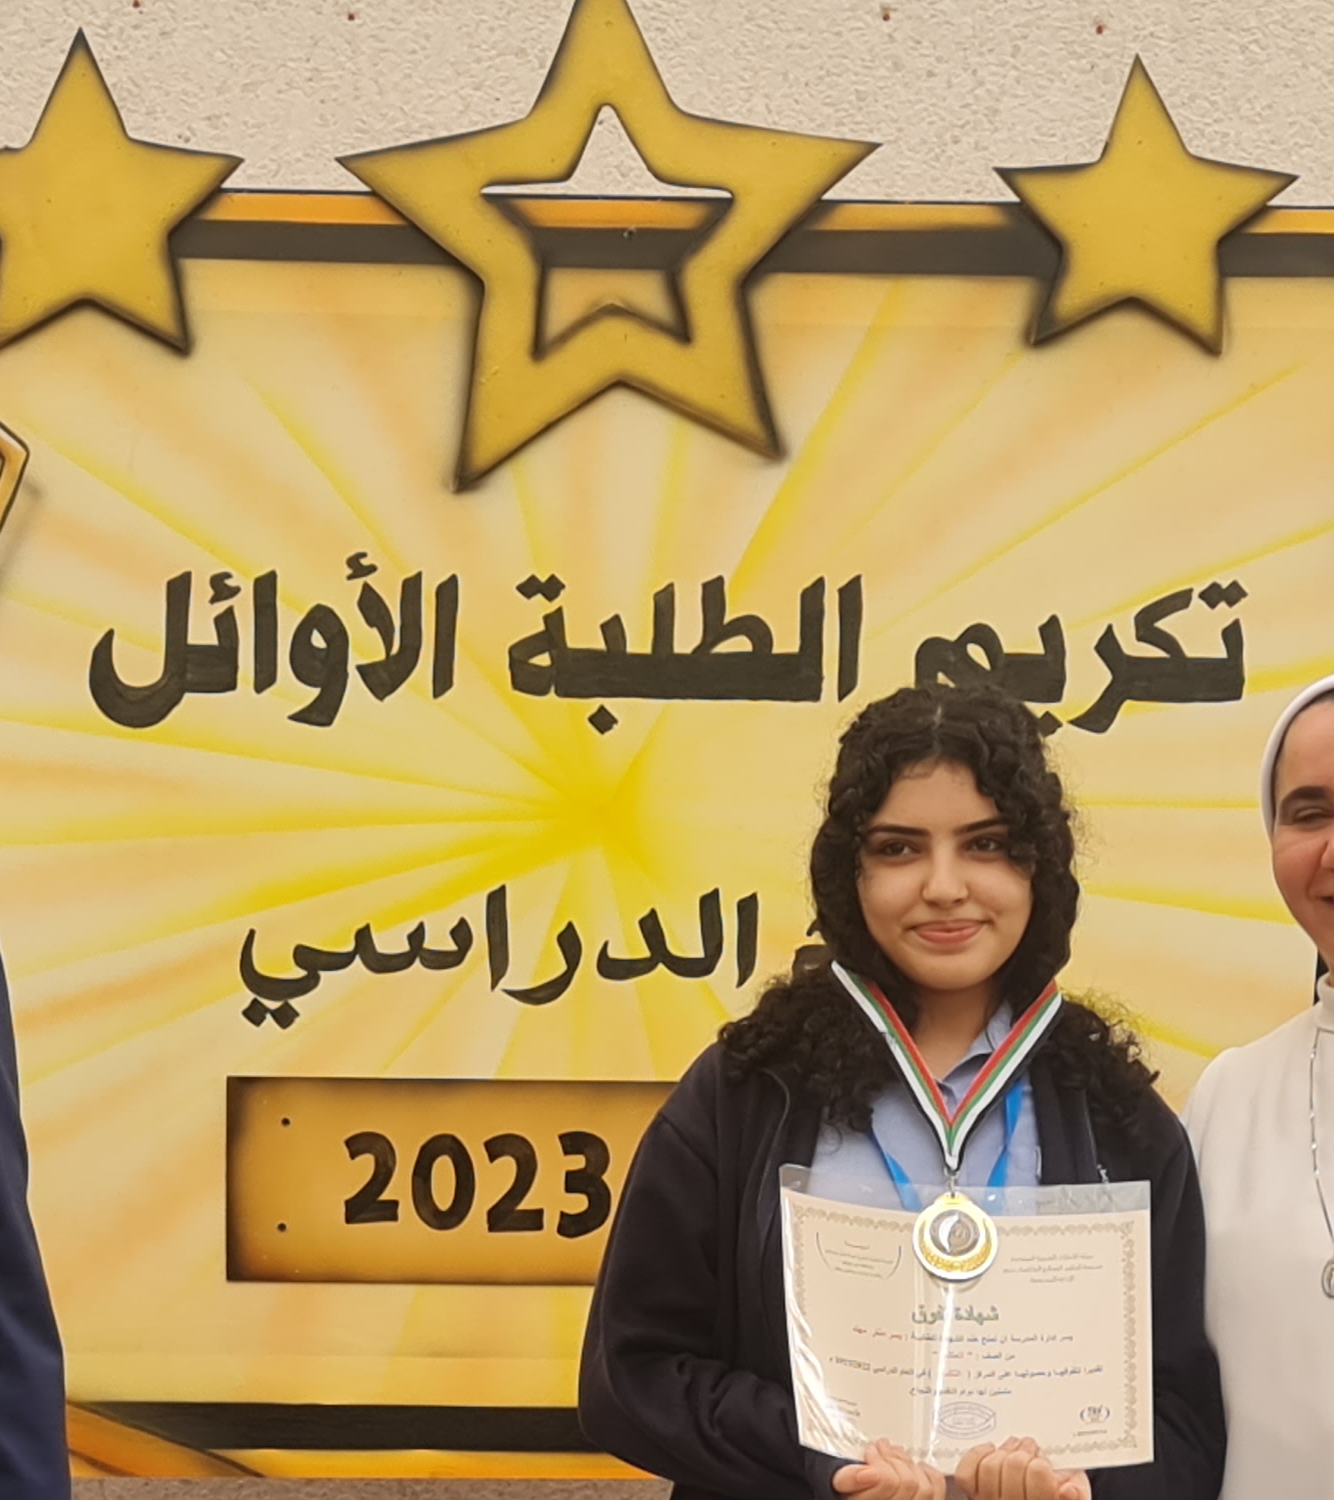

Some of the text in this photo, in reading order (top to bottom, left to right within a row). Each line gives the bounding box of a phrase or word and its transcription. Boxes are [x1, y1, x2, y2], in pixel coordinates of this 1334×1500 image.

[88, 551, 1249, 737] تكريم الطلبة الأوائل
[239, 883, 759, 1031] الدراسي
[344, 1131, 612, 1239] 2023
[911, 1304, 948, 1325] فوق
